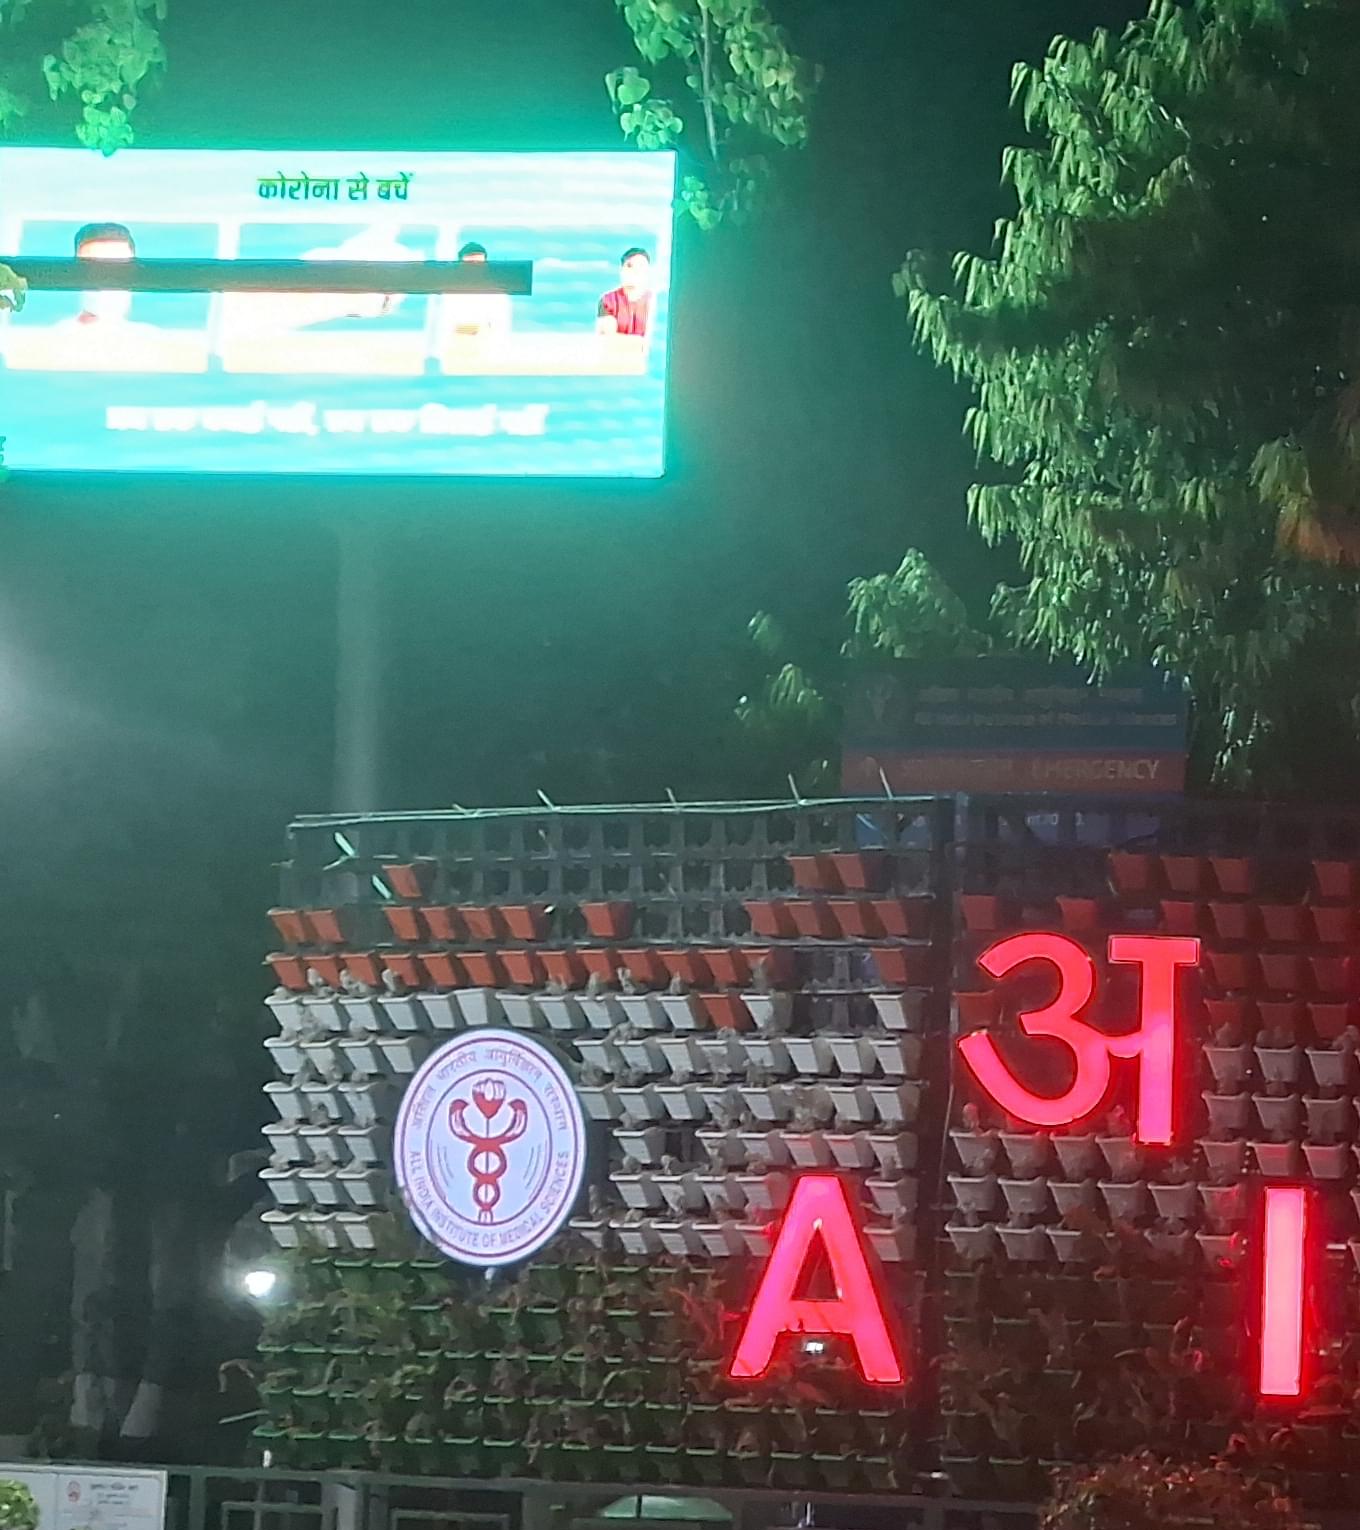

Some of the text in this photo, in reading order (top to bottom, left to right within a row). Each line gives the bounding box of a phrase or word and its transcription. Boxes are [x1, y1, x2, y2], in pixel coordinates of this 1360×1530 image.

[257, 170, 414, 200] कोरोना से बचें
[410, 1150, 422, 1171] ALL
[414, 1175, 433, 1211] INDIA
[540, 1151, 570, 1215] SCIENCES
[431, 1208, 479, 1248] INSTITUTE
[482, 1234, 498, 1248] OF
